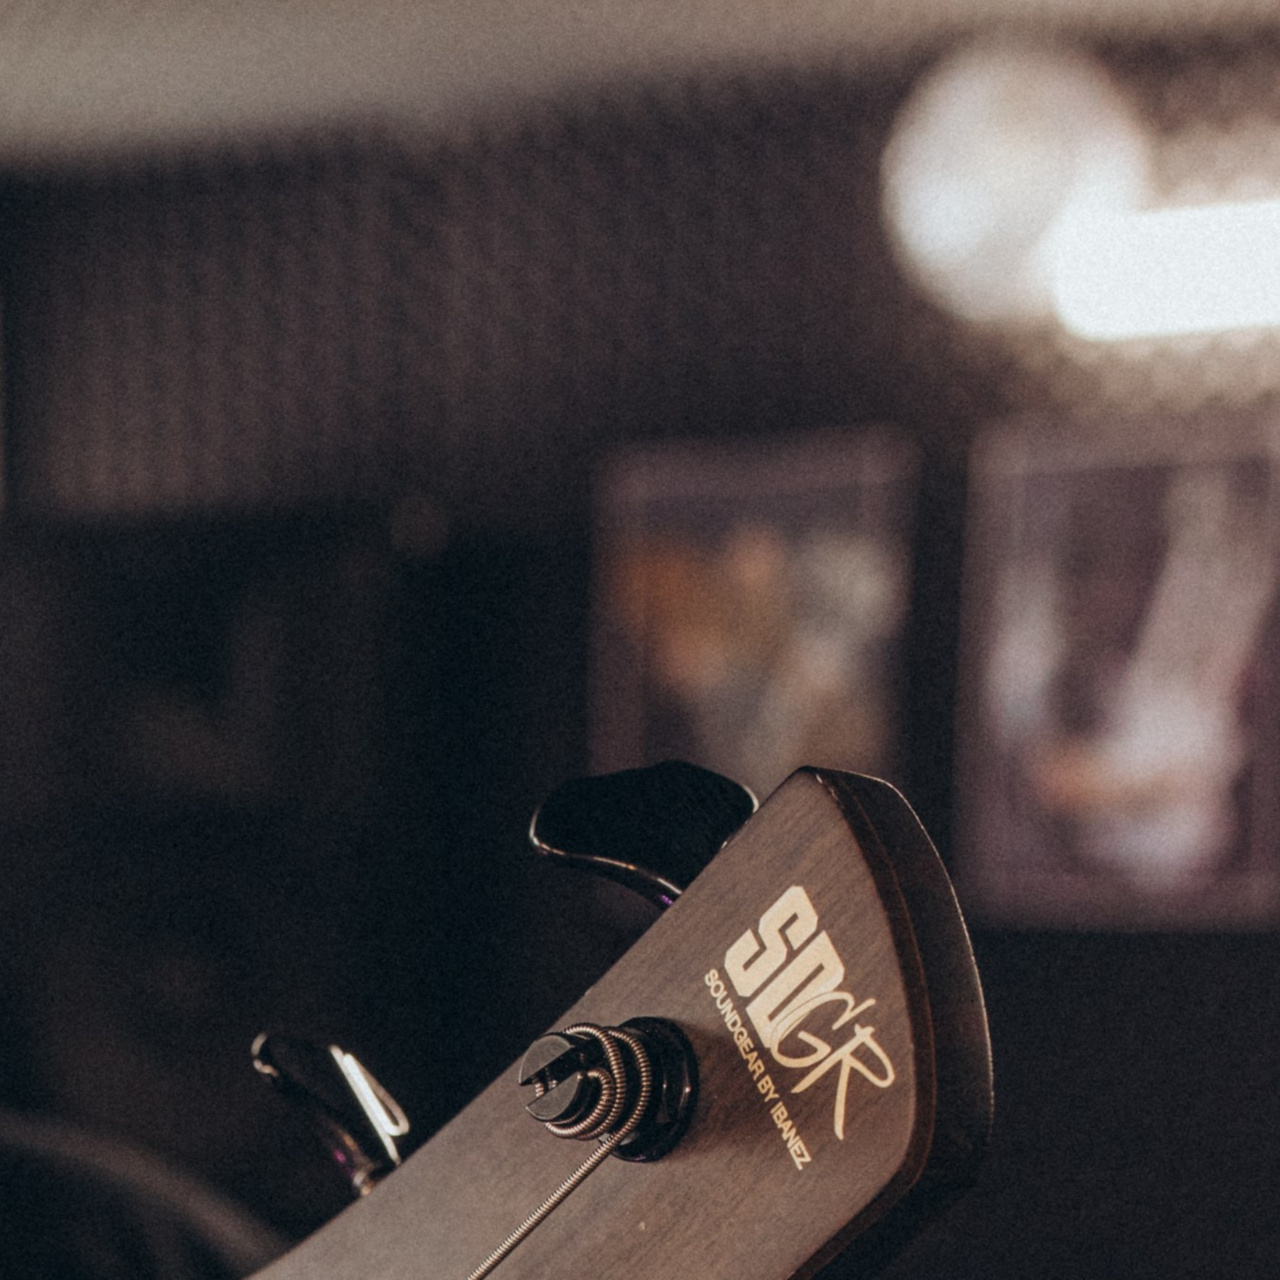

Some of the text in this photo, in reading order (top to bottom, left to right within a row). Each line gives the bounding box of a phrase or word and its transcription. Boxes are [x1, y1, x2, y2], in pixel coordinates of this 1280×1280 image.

[704, 968, 812, 1170] SOUNDGEAR BY IBANEZ
[724, 885, 895, 1140] SDGR
